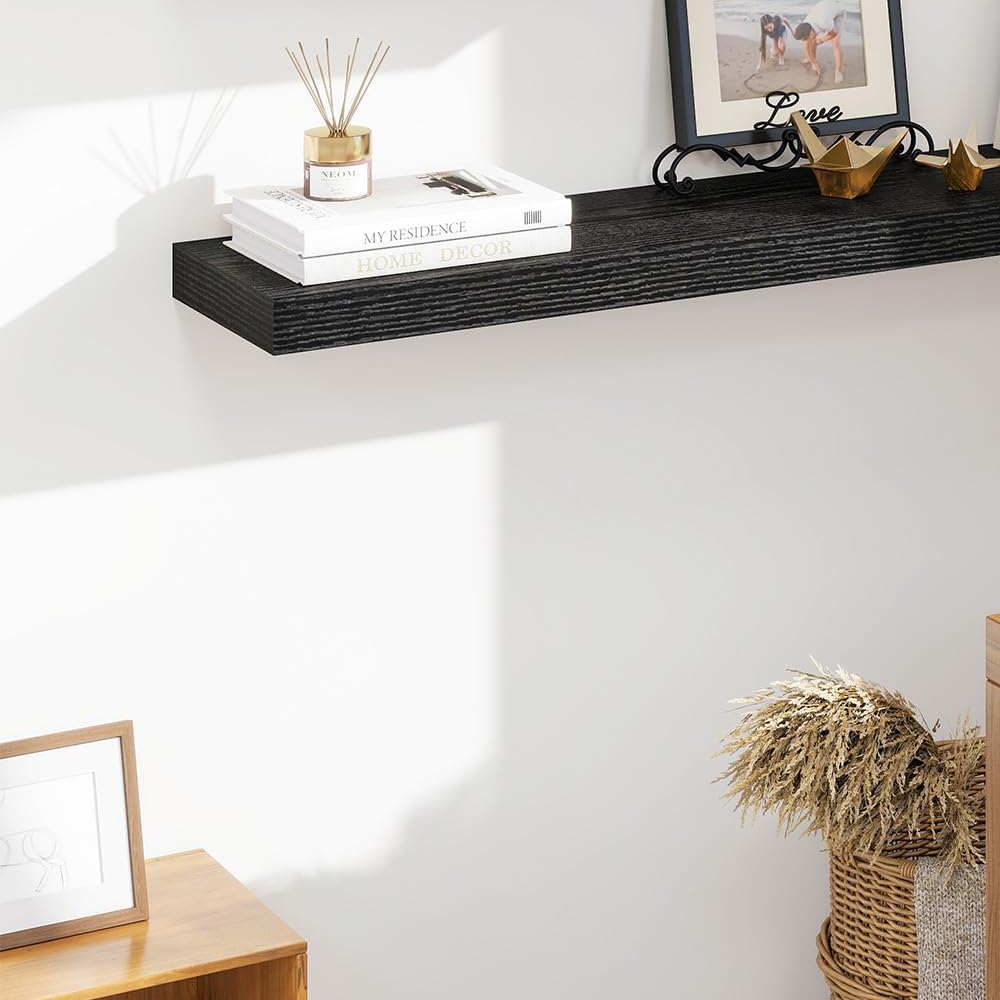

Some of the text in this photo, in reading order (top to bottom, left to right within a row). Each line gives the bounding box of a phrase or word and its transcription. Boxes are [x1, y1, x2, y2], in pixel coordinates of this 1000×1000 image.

[363, 221, 467, 245] MY RESIDENCE
[357, 240, 512, 273] HOME DECOR
